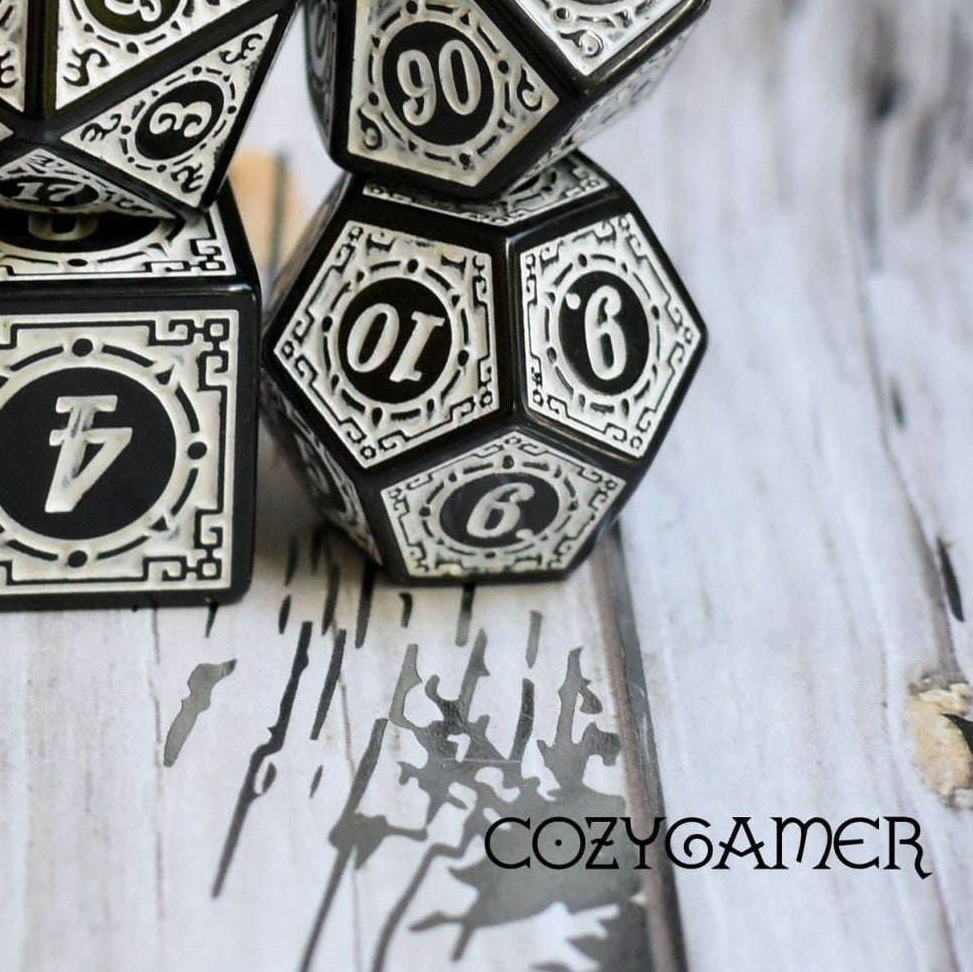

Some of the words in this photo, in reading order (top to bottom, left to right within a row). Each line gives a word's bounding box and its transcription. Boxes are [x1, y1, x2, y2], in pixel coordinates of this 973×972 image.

[149, 99, 214, 139] 3
[396, 38, 483, 127] 90
[11, 181, 88, 203] 17
[346, 301, 446, 384] 10
[43, 394, 134, 514] 4
